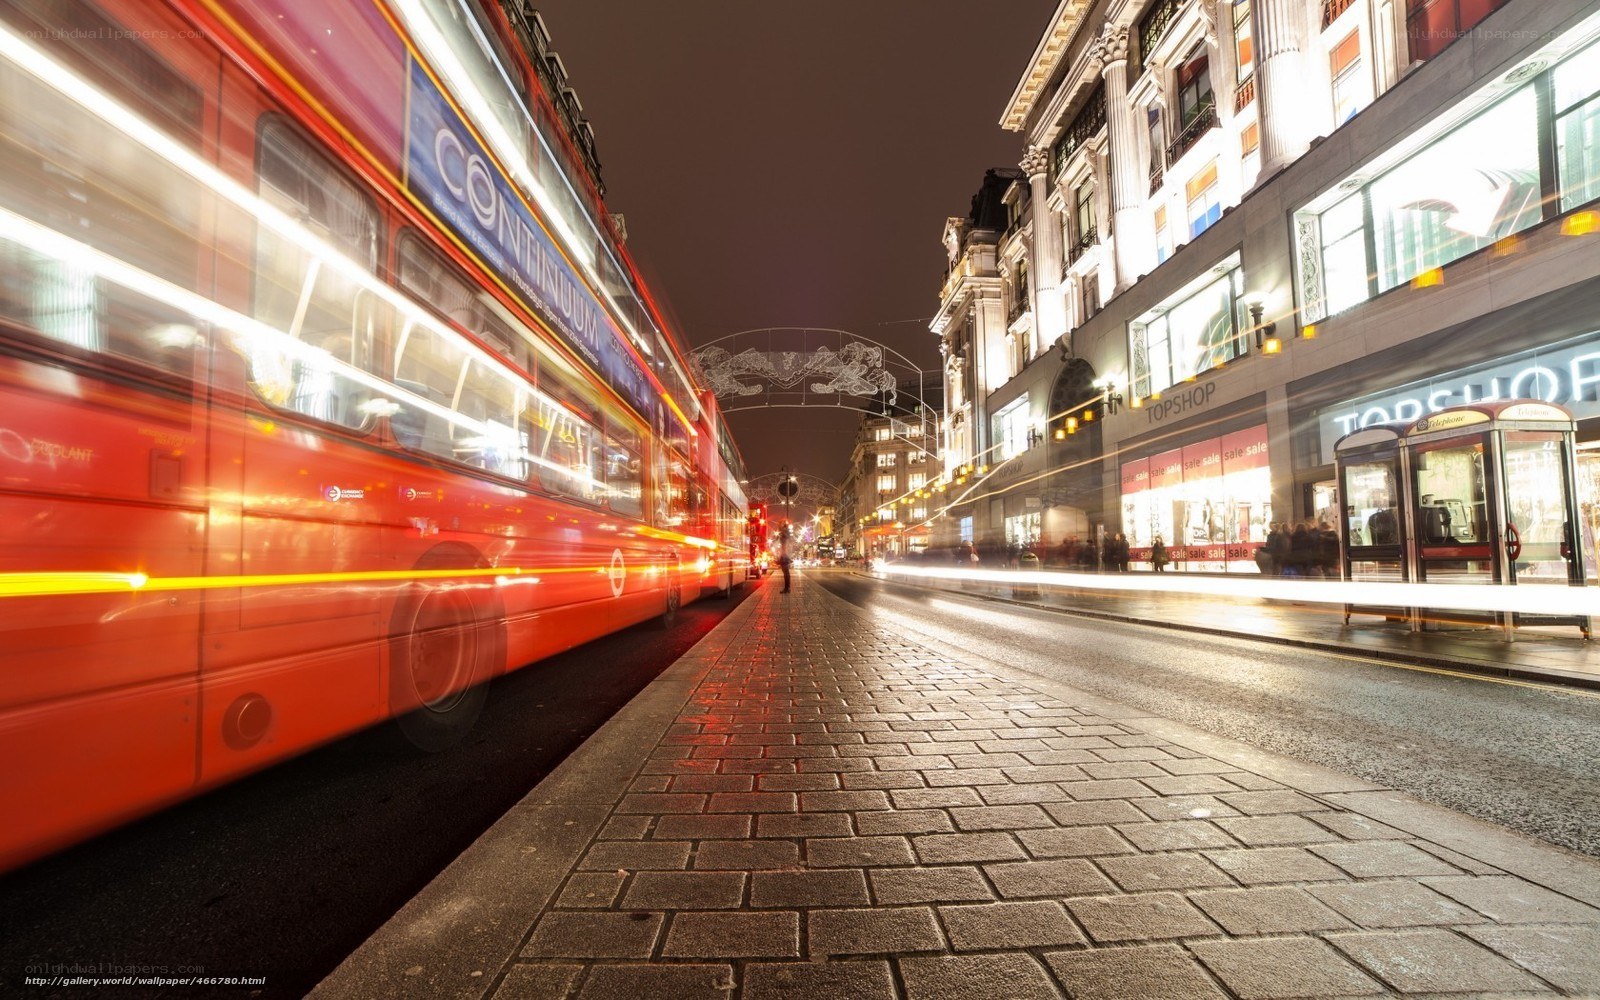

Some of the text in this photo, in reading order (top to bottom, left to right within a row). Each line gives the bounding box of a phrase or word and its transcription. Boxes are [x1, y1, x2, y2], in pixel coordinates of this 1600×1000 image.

[435, 128, 599, 351] CONTINUUM
[1145, 381, 1216, 424] TOPSHOP
[1428, 414, 1465, 429] Telephone
[1135, 471, 1149, 481] sale
[1151, 466, 1165, 478] sale
[1166, 462, 1181, 474] sale
[1184, 458, 1200, 471] sale
[1202, 452, 1220, 466] sale
[1224, 447, 1243, 461] sale
[1246, 441, 1268, 456] sale
[1171, 549, 1187, 559] sale
[1189, 548, 1206, 559] sale
[1208, 547, 1226, 558] sale
[1229, 547, 1248, 558] sale
